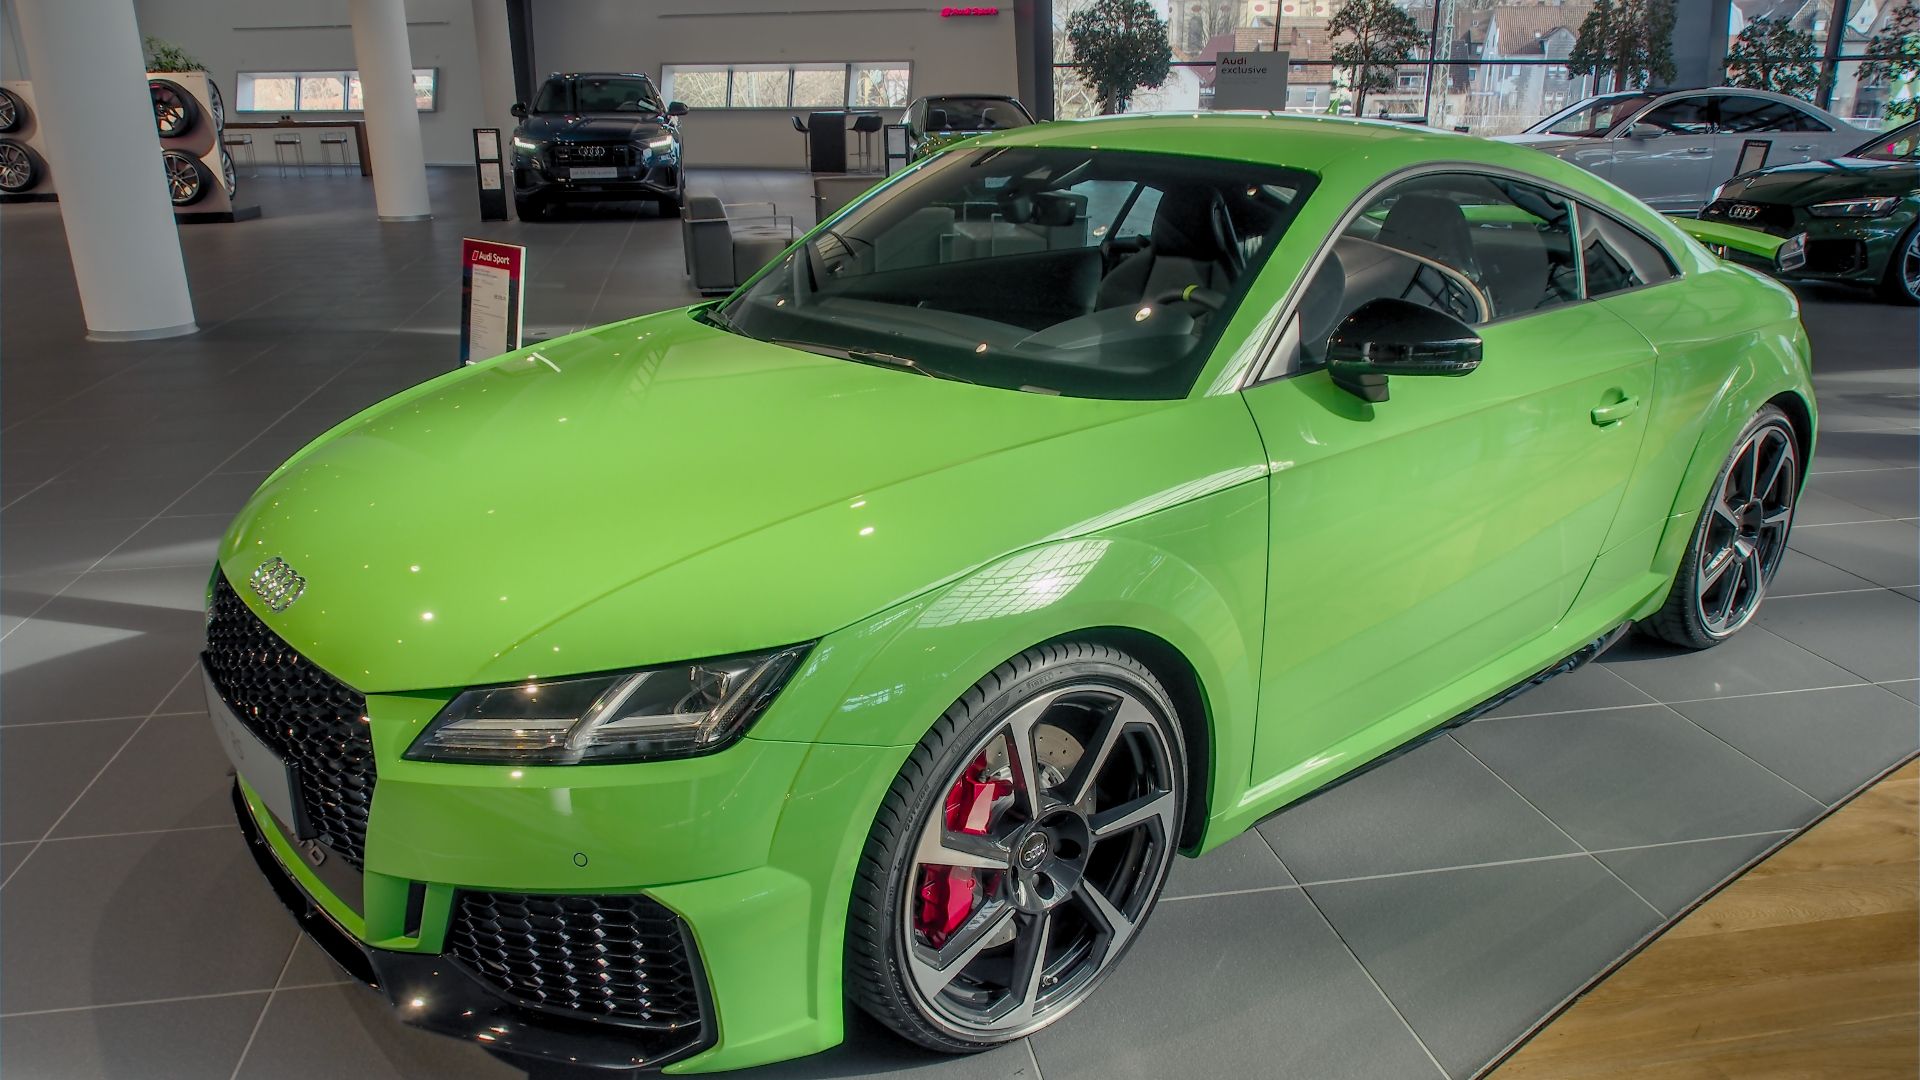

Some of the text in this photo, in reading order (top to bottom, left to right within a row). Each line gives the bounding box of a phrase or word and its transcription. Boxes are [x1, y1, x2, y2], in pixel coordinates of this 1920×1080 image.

[1222, 57, 1247, 65] Audi
[1221, 66, 1268, 74] exclusive
[479, 251, 510, 265] Audi Sport
